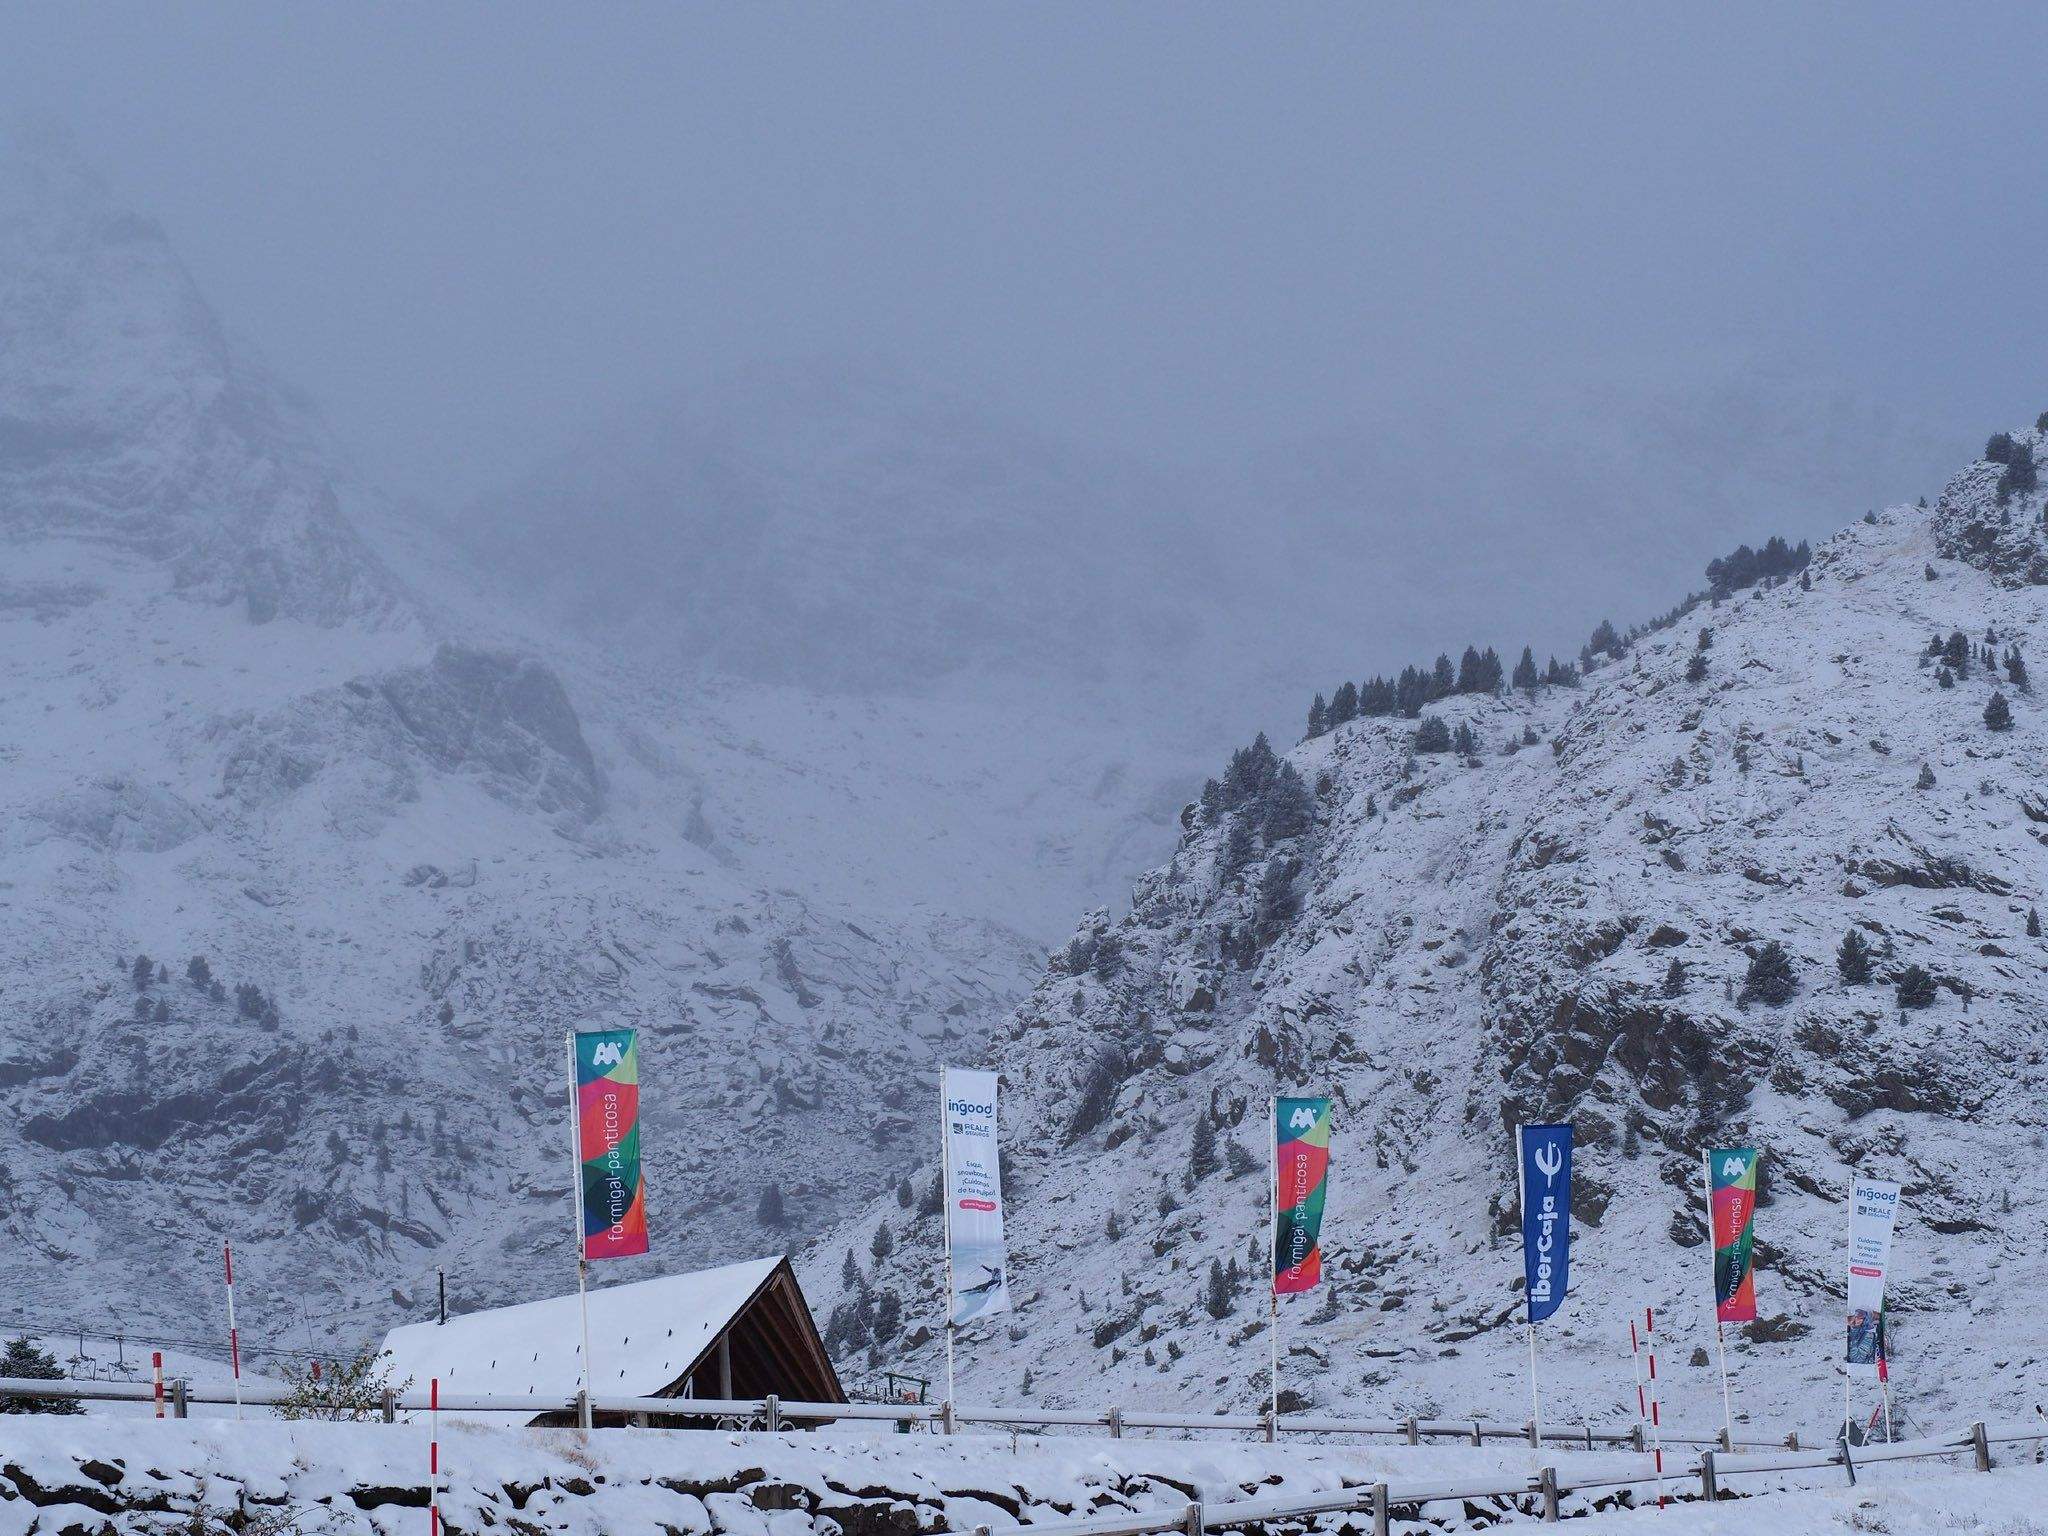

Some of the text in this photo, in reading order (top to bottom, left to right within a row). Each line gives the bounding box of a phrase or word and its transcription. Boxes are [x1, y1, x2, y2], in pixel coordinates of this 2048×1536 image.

[948, 1099, 993, 1118] ingood
[964, 1124, 989, 1132] REALE
[1856, 1187, 1897, 1204] ingood
[1868, 1206, 1891, 1215] REALE
[1530, 1196, 1559, 1303] ibercaja
